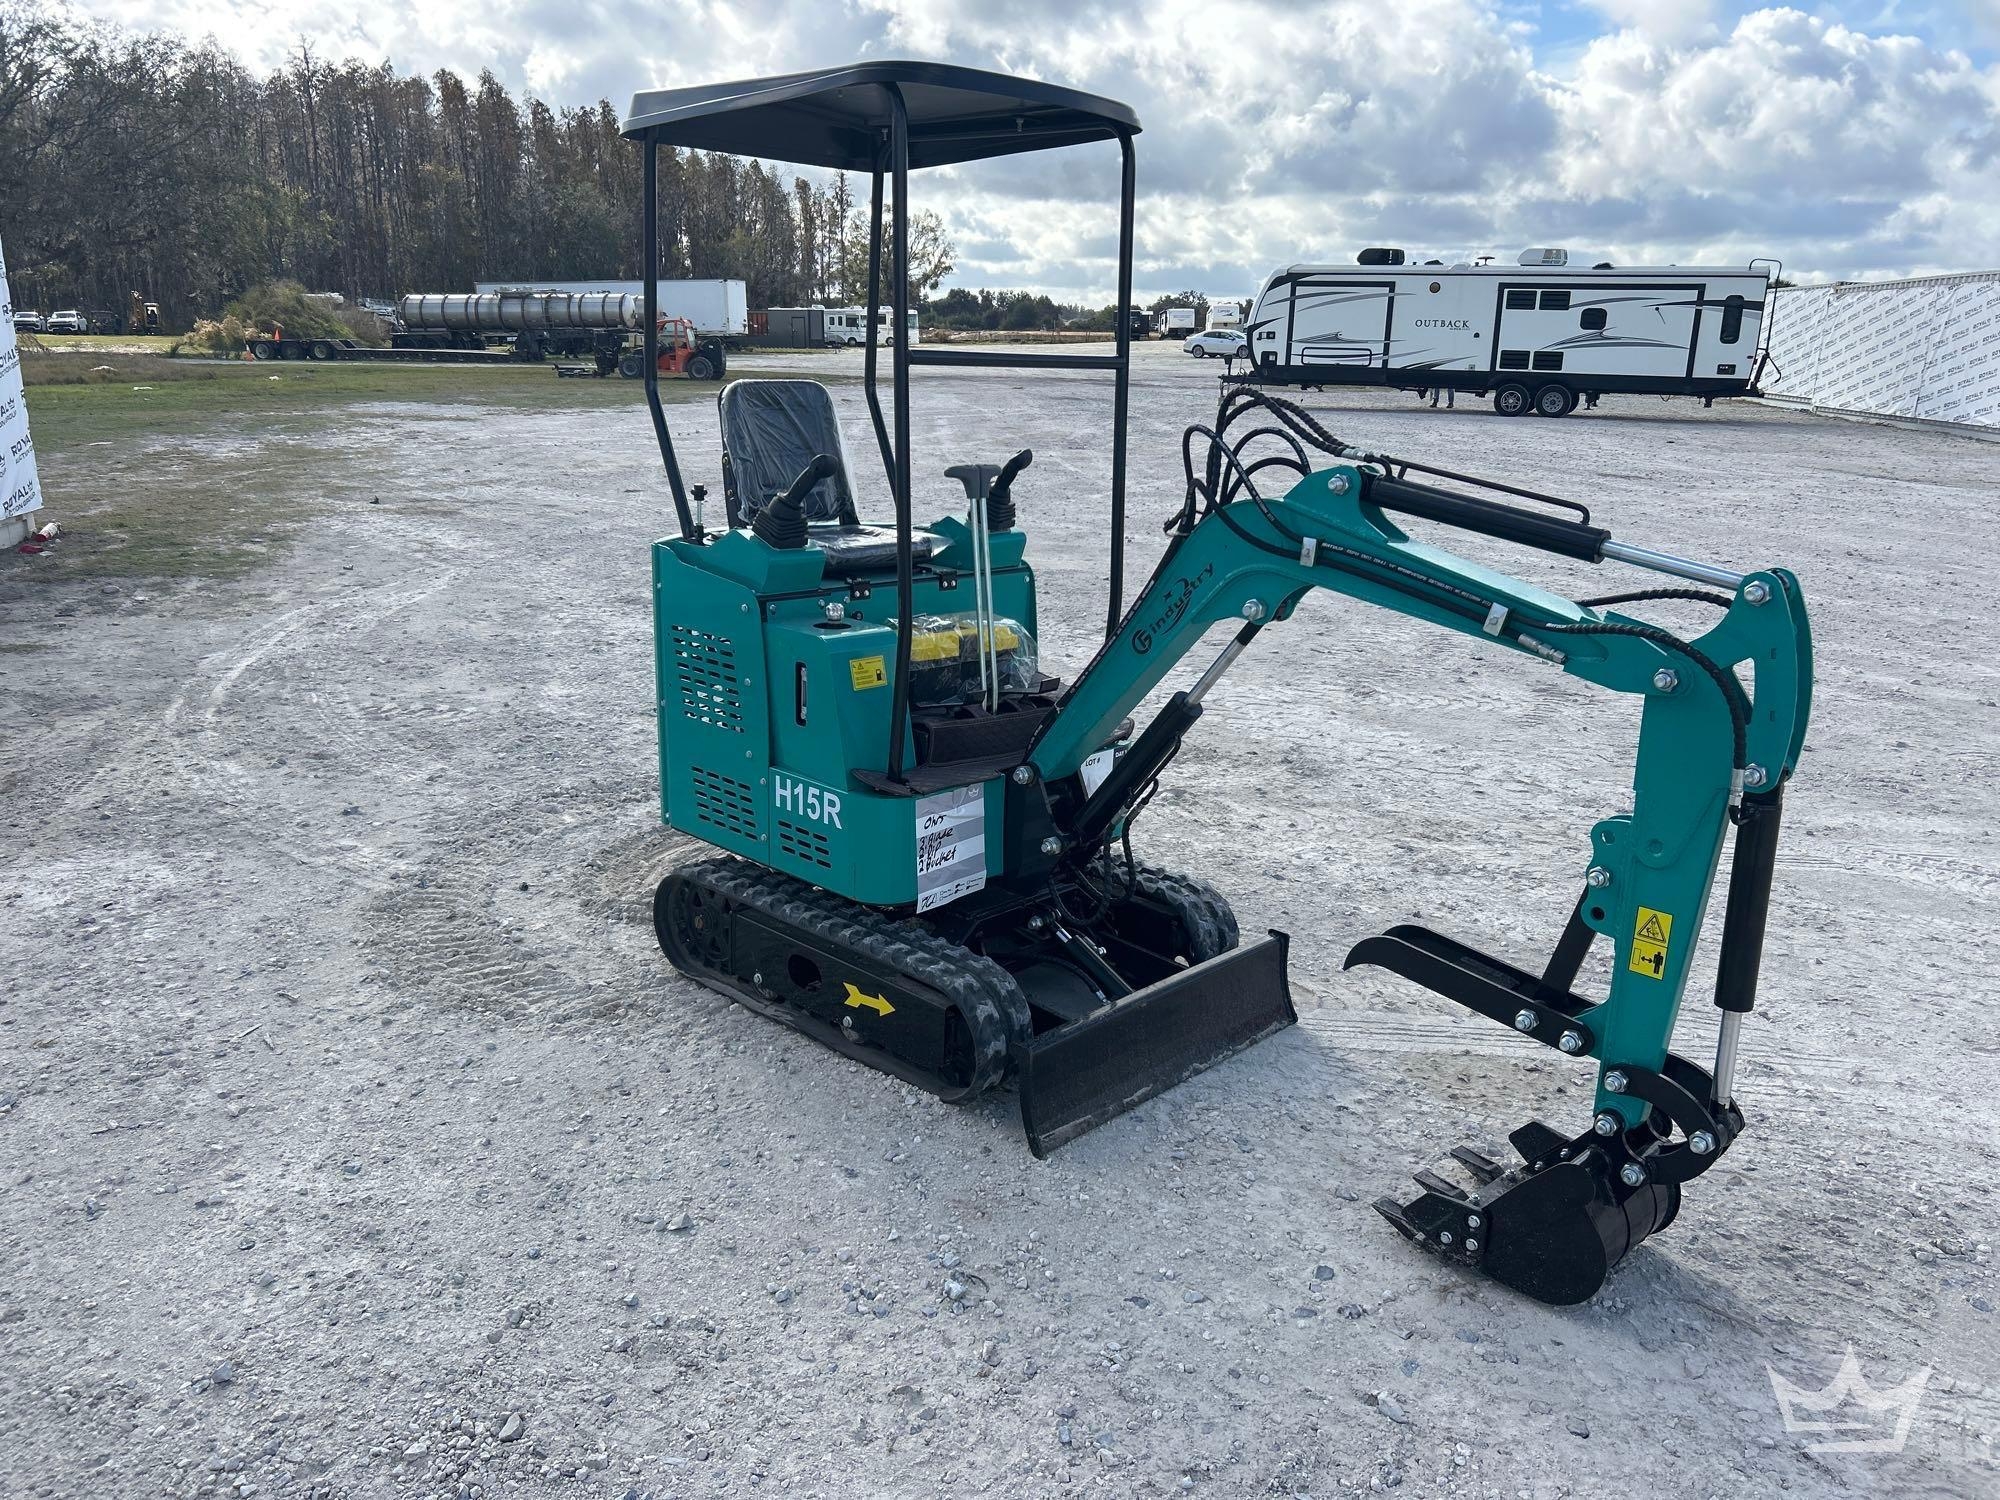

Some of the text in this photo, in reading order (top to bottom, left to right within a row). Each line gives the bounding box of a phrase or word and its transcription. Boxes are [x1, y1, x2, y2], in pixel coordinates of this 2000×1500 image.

[1415, 319, 1469, 328] OUTBACK
[2, 486, 28, 513] ROYAL
[1086, 758, 1096, 766] LOT
[776, 775, 842, 830] H15R
